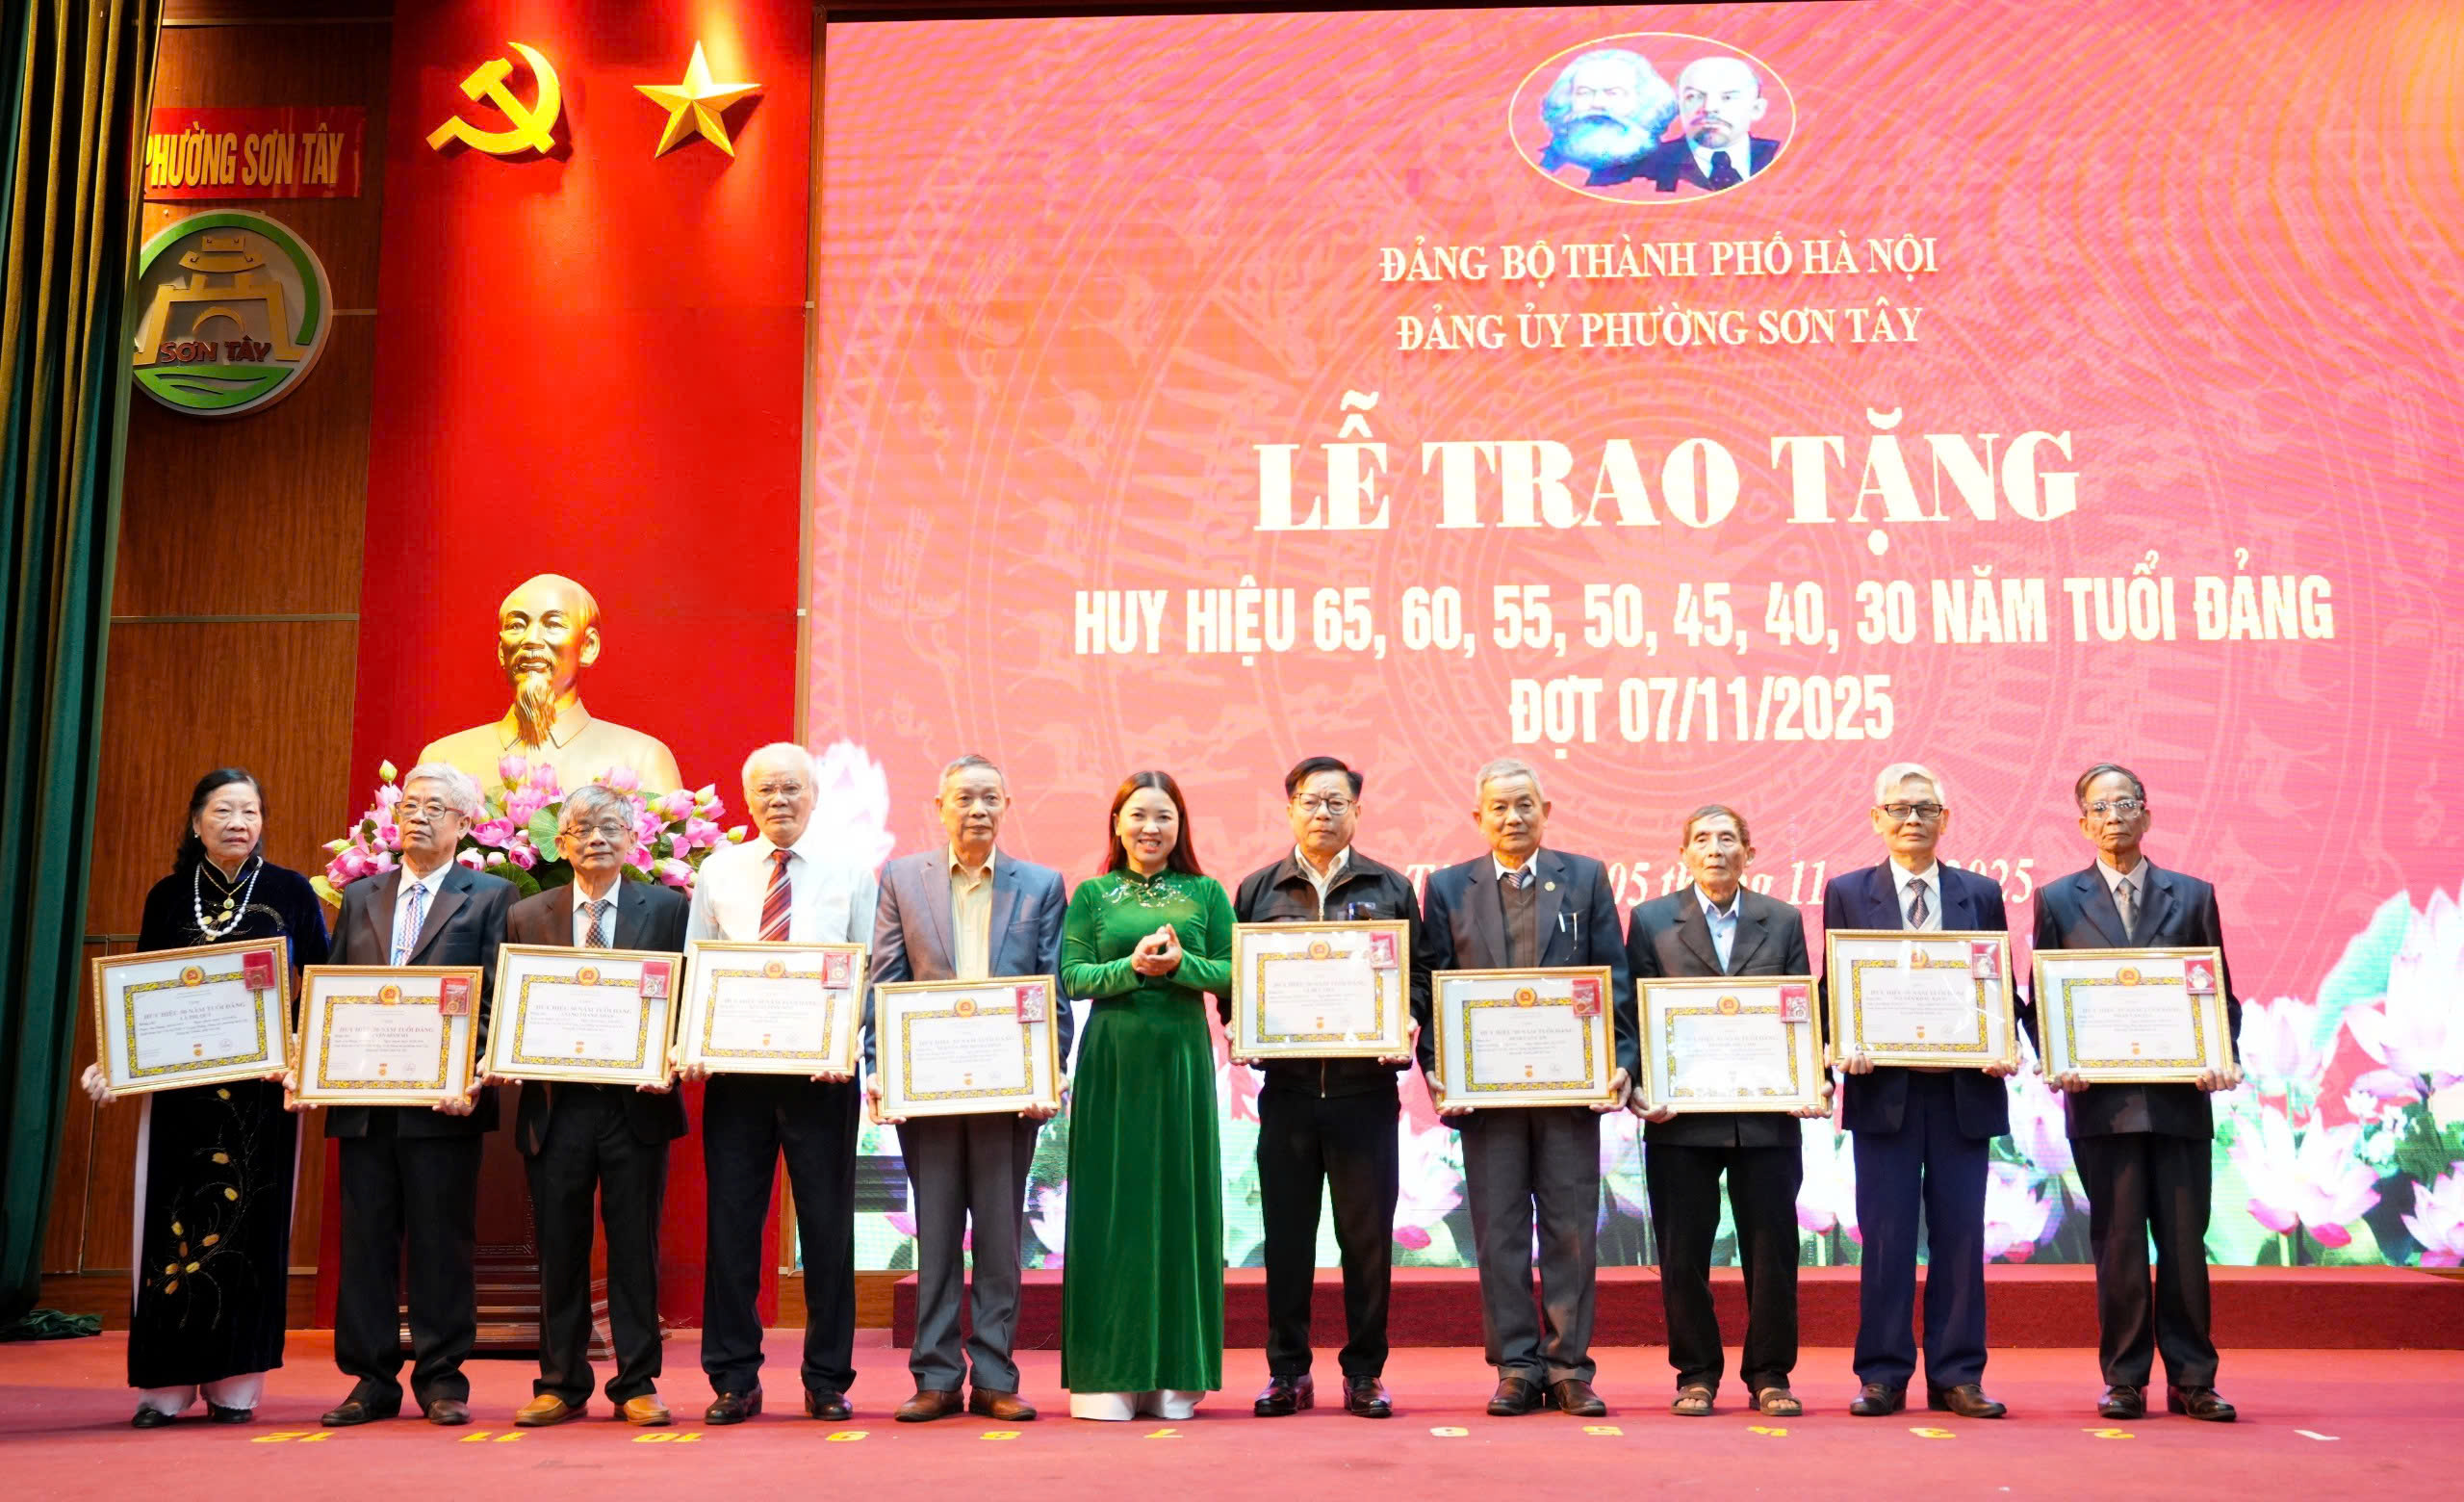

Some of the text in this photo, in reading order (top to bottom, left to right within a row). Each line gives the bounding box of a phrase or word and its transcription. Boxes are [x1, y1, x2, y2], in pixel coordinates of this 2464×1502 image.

[242, 128, 295, 186] SƠN
[301, 122, 346, 185] TÂY
[1379, 230, 1938, 289] ĐẢNG BỘ THÀNH PHỐ HÀ NỘI
[160, 334, 272, 363] SƠN TÂY
[1397, 296, 1923, 351] ĐẢNG ỦY PHƯỜNG SƠN TÂY
[1253, 390, 2080, 557] LỄ TRAO TẶNG
[1074, 548, 2335, 666] HUY HIỆU 65, 60, 55, 50, 45, 40, 30 NĂM TUỔI ĐẢNG
[1508, 673, 1895, 760] ĐỢT 07/11/2025
[1607, 858, 2035, 907] 05 thg 11 25
[251, 1431, 336, 1443] 12
[458, 1431, 527, 1443] 11
[630, 1431, 704, 1444] 10
[1142, 1428, 1183, 1439] 7
